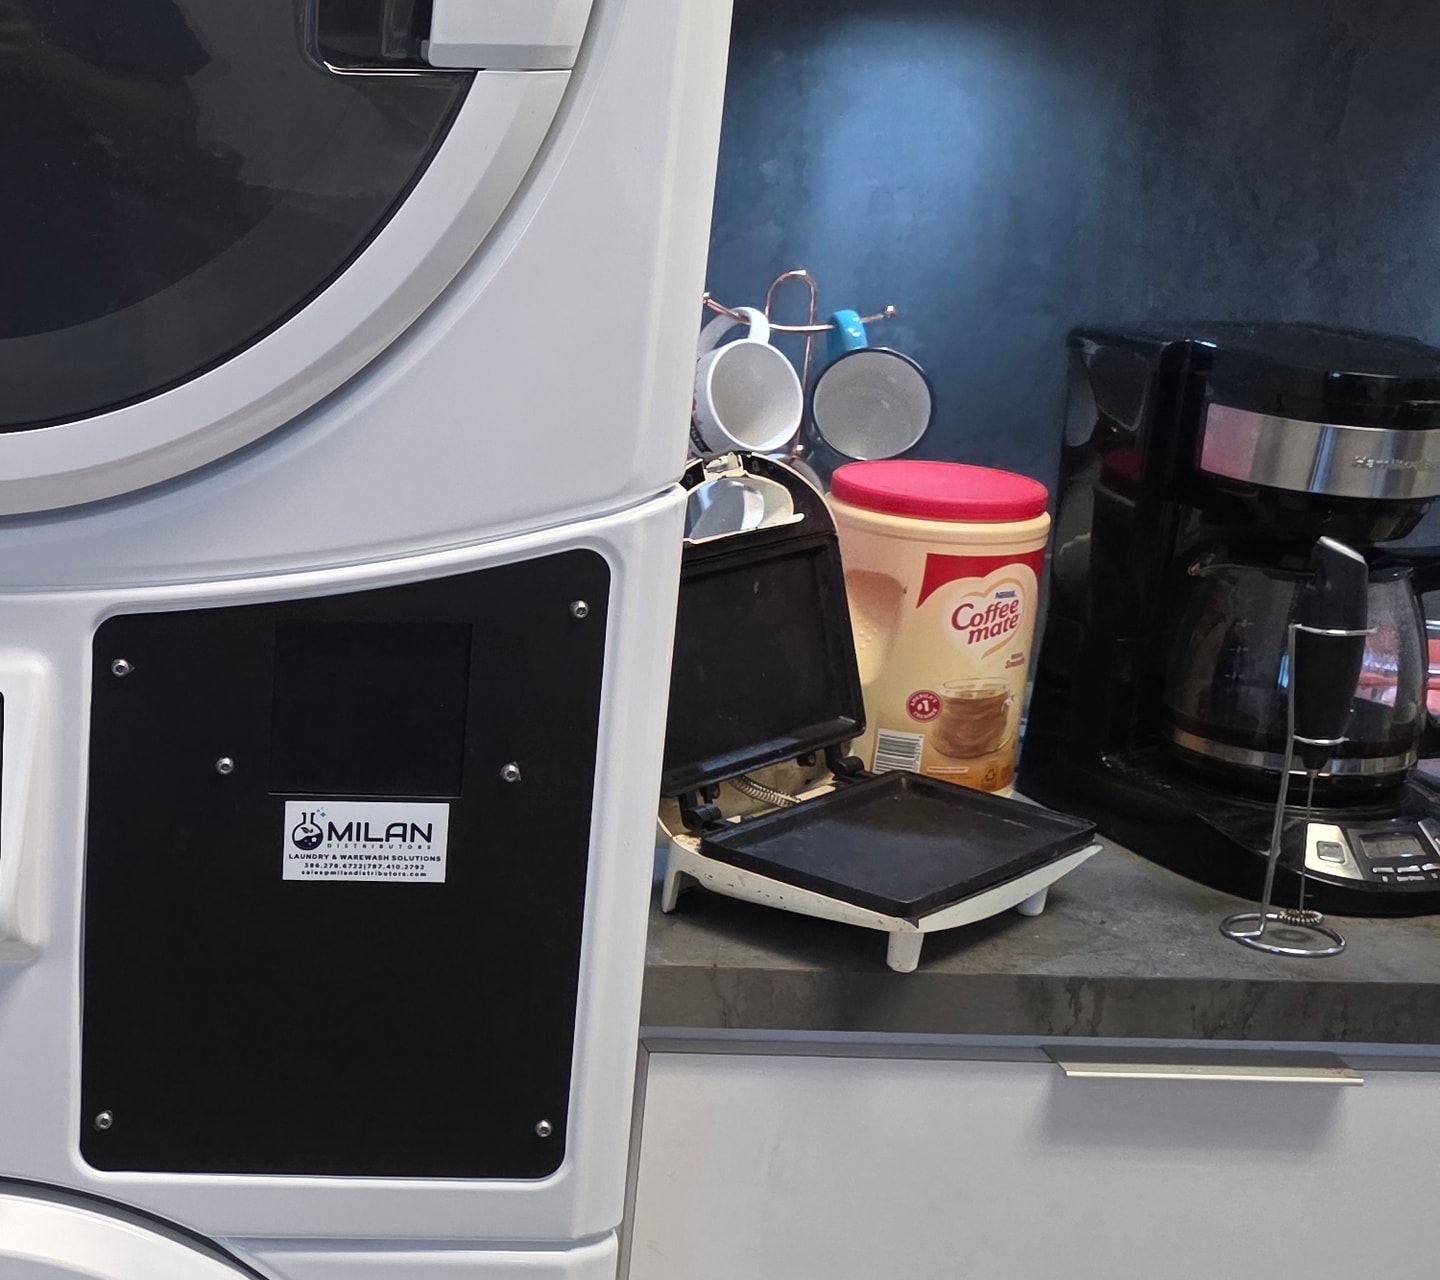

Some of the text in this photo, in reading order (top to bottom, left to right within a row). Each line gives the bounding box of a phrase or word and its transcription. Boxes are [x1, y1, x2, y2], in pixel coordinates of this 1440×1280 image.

[951, 599, 1020, 631] Coffee
[967, 613, 1019, 644] mate
[327, 821, 433, 843] MILAN
